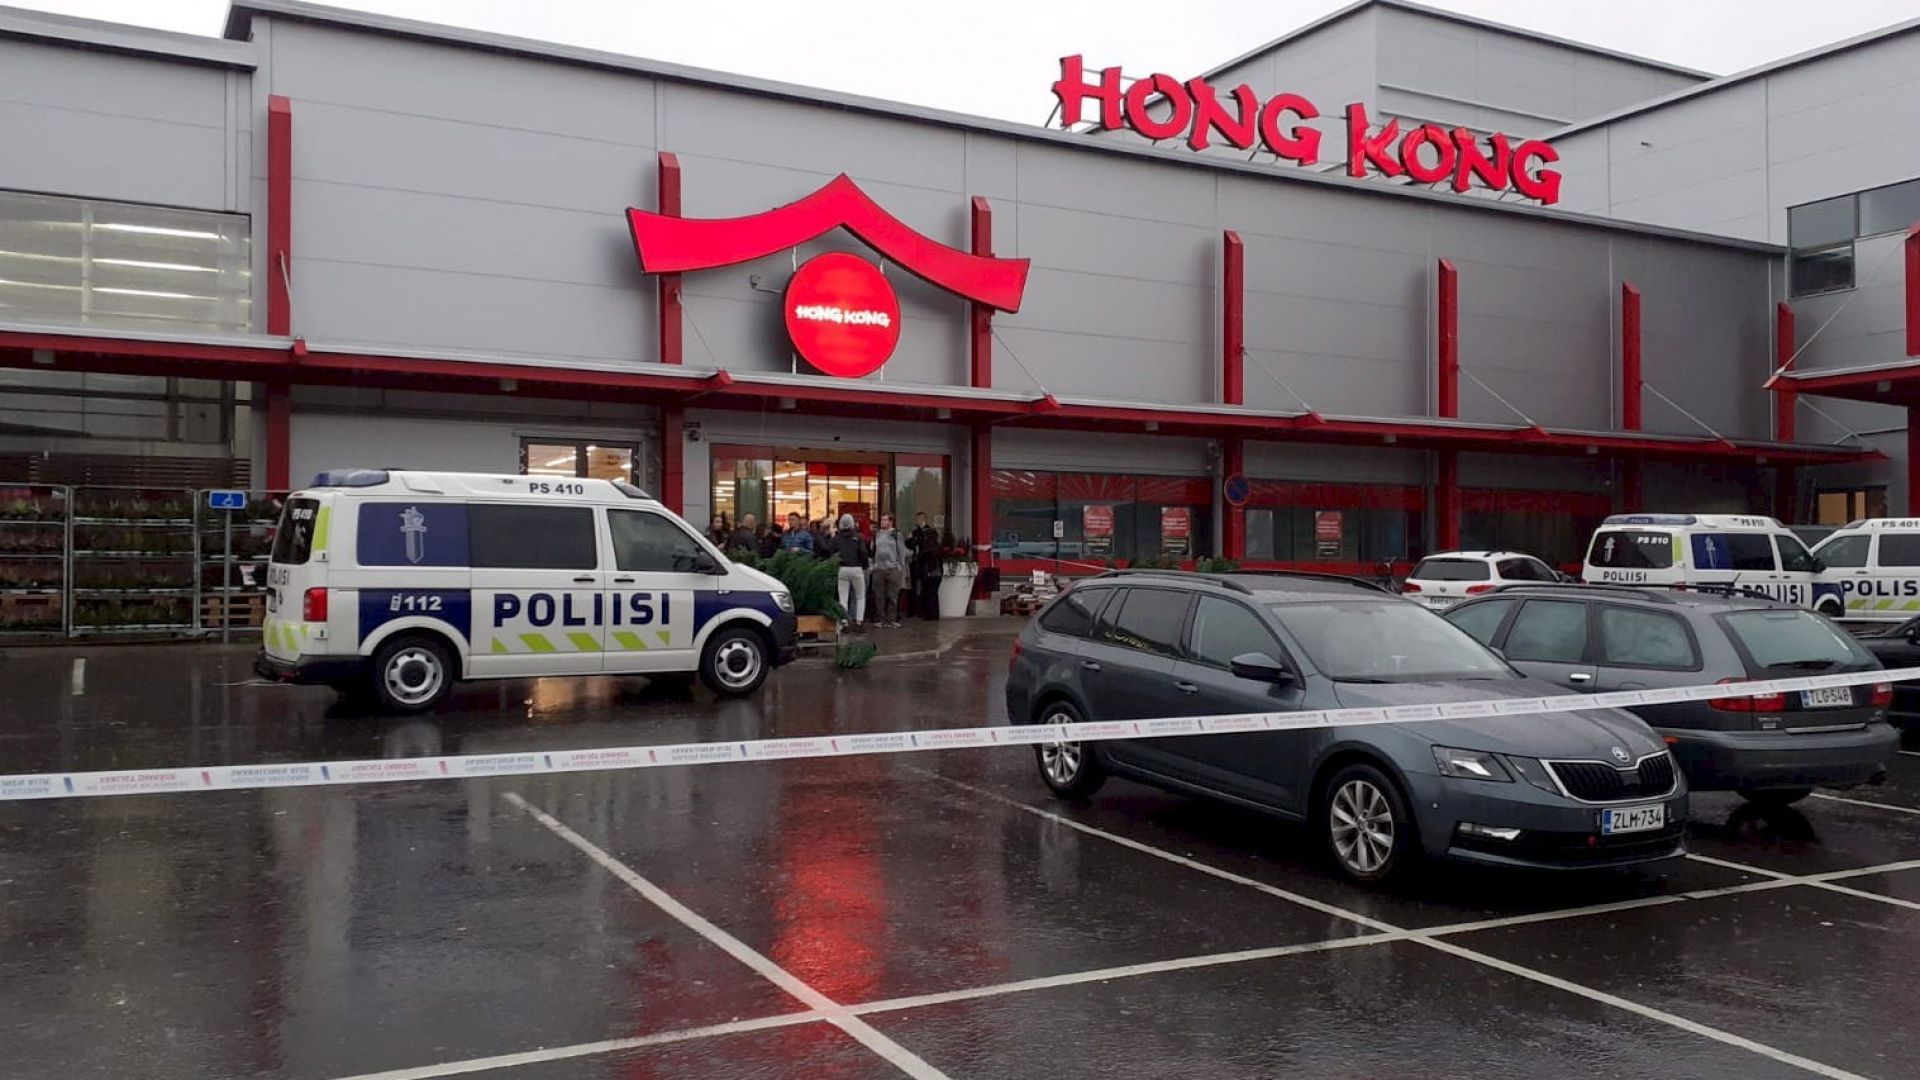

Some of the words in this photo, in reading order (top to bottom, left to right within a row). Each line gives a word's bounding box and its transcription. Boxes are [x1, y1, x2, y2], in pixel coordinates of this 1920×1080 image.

[1052, 54, 1322, 166] HONG
[1346, 102, 1561, 205] KONG
[795, 305, 843, 323] HONG
[844, 310, 891, 328] KONG
[529, 482, 550, 494] PS
[555, 484, 584, 495] 410
[1881, 520, 1896, 528] PS
[1900, 520, 1919, 528] 401
[1637, 536, 1650, 544] PS
[1603, 571, 1647, 582] POLIISI
[1841, 580, 1918, 596] POLIS
[404, 595, 443, 611] 112
[493, 593, 670, 627] POLIISI
[1613, 809, 1662, 829] ZLM-734
